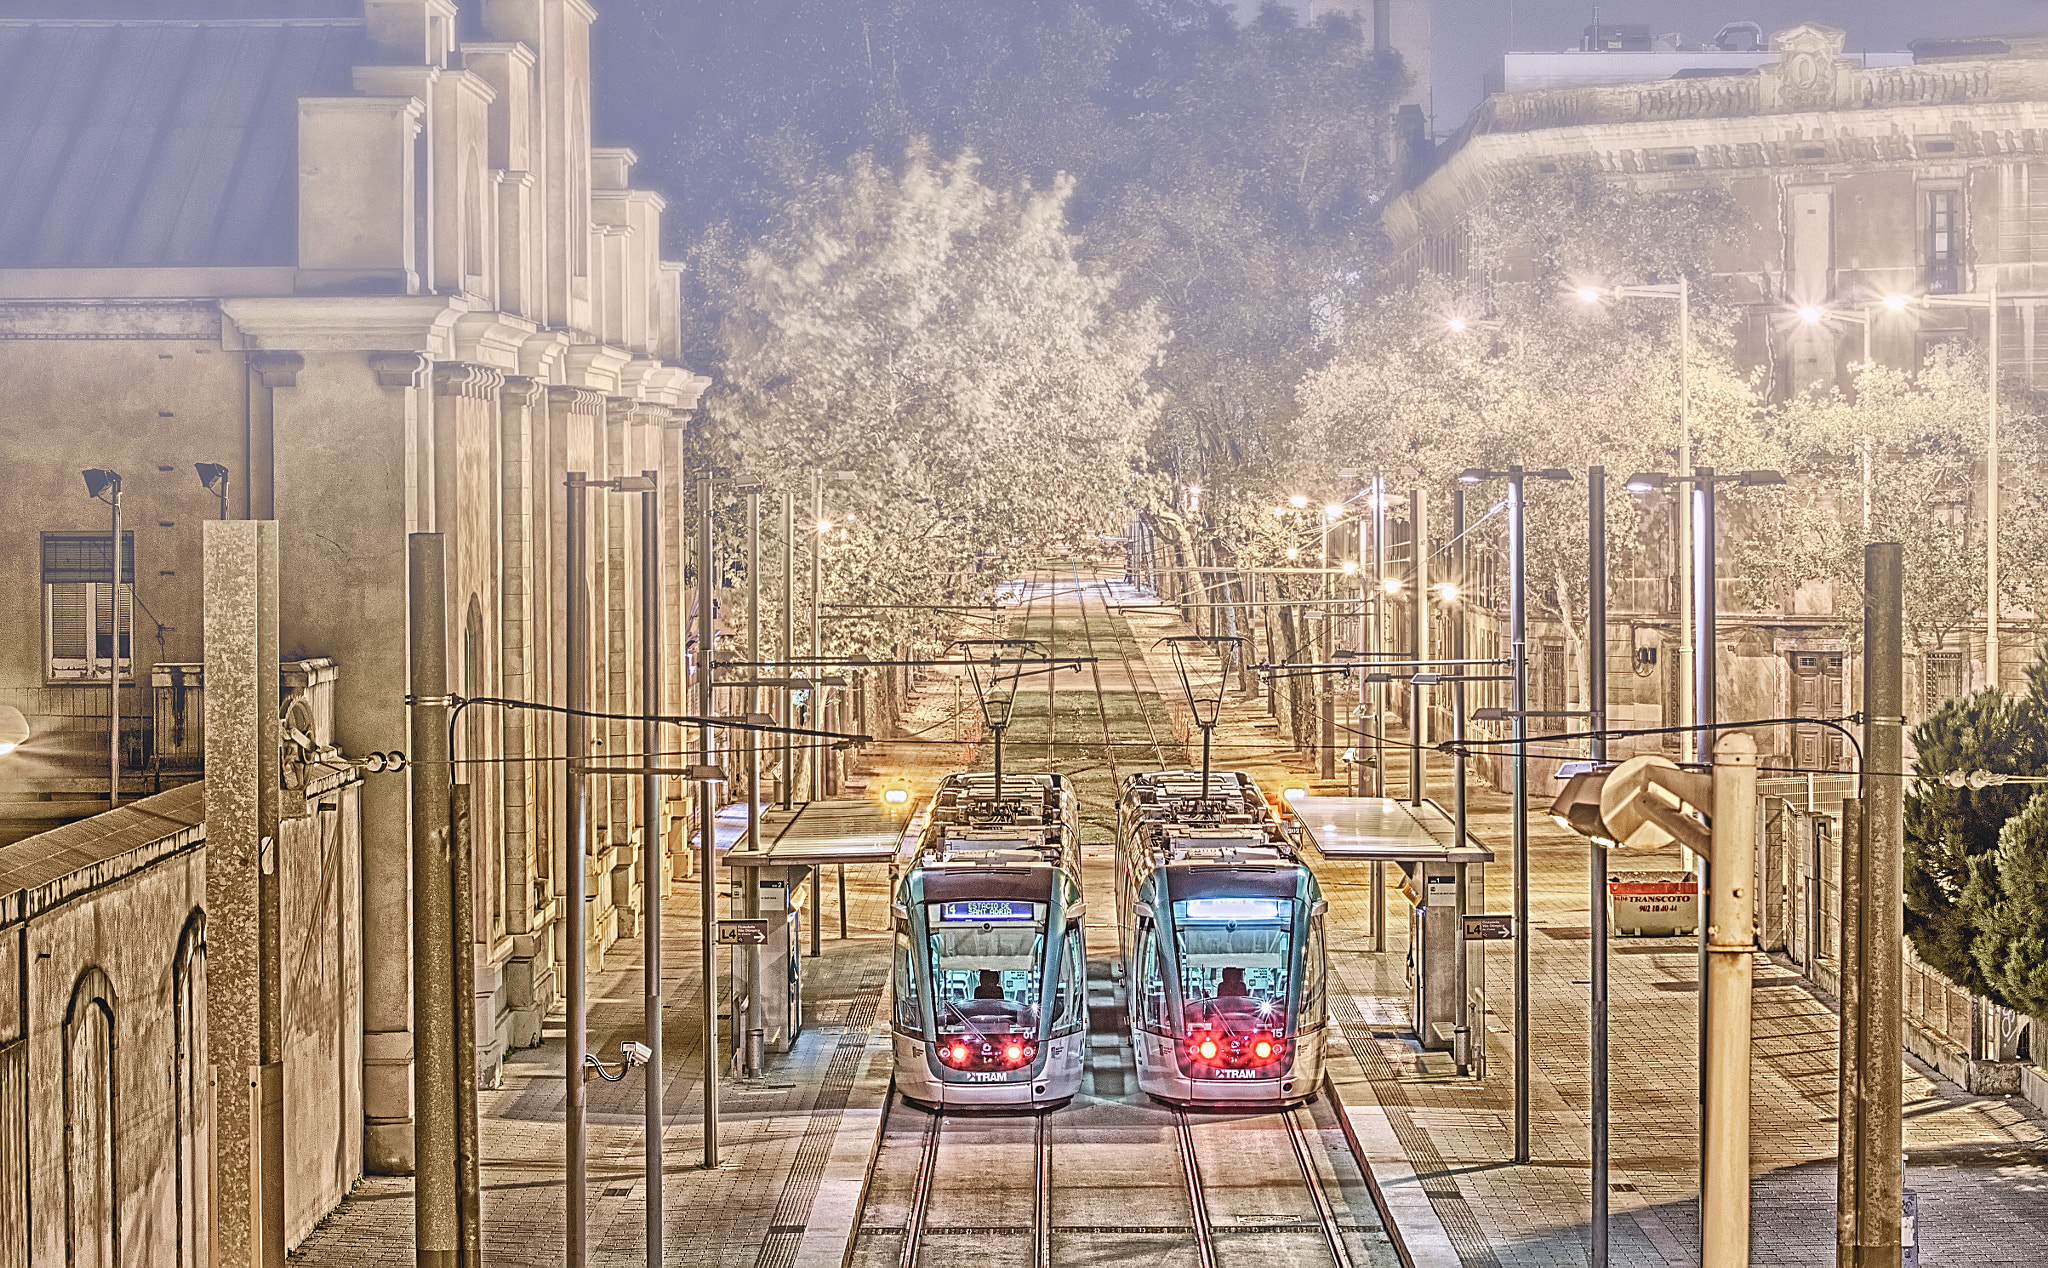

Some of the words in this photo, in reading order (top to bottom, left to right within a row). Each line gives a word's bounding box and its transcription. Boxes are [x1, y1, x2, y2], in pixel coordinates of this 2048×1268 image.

[944, 904, 956, 914] T4
[721, 929, 736, 939] L4
[1466, 925, 1481, 934] L4
[1023, 1031, 1034, 1039] 01
[1271, 1029, 1283, 1038] 15
[976, 1072, 1007, 1081] TRAM
[1225, 1069, 1256, 1078] TRAM
